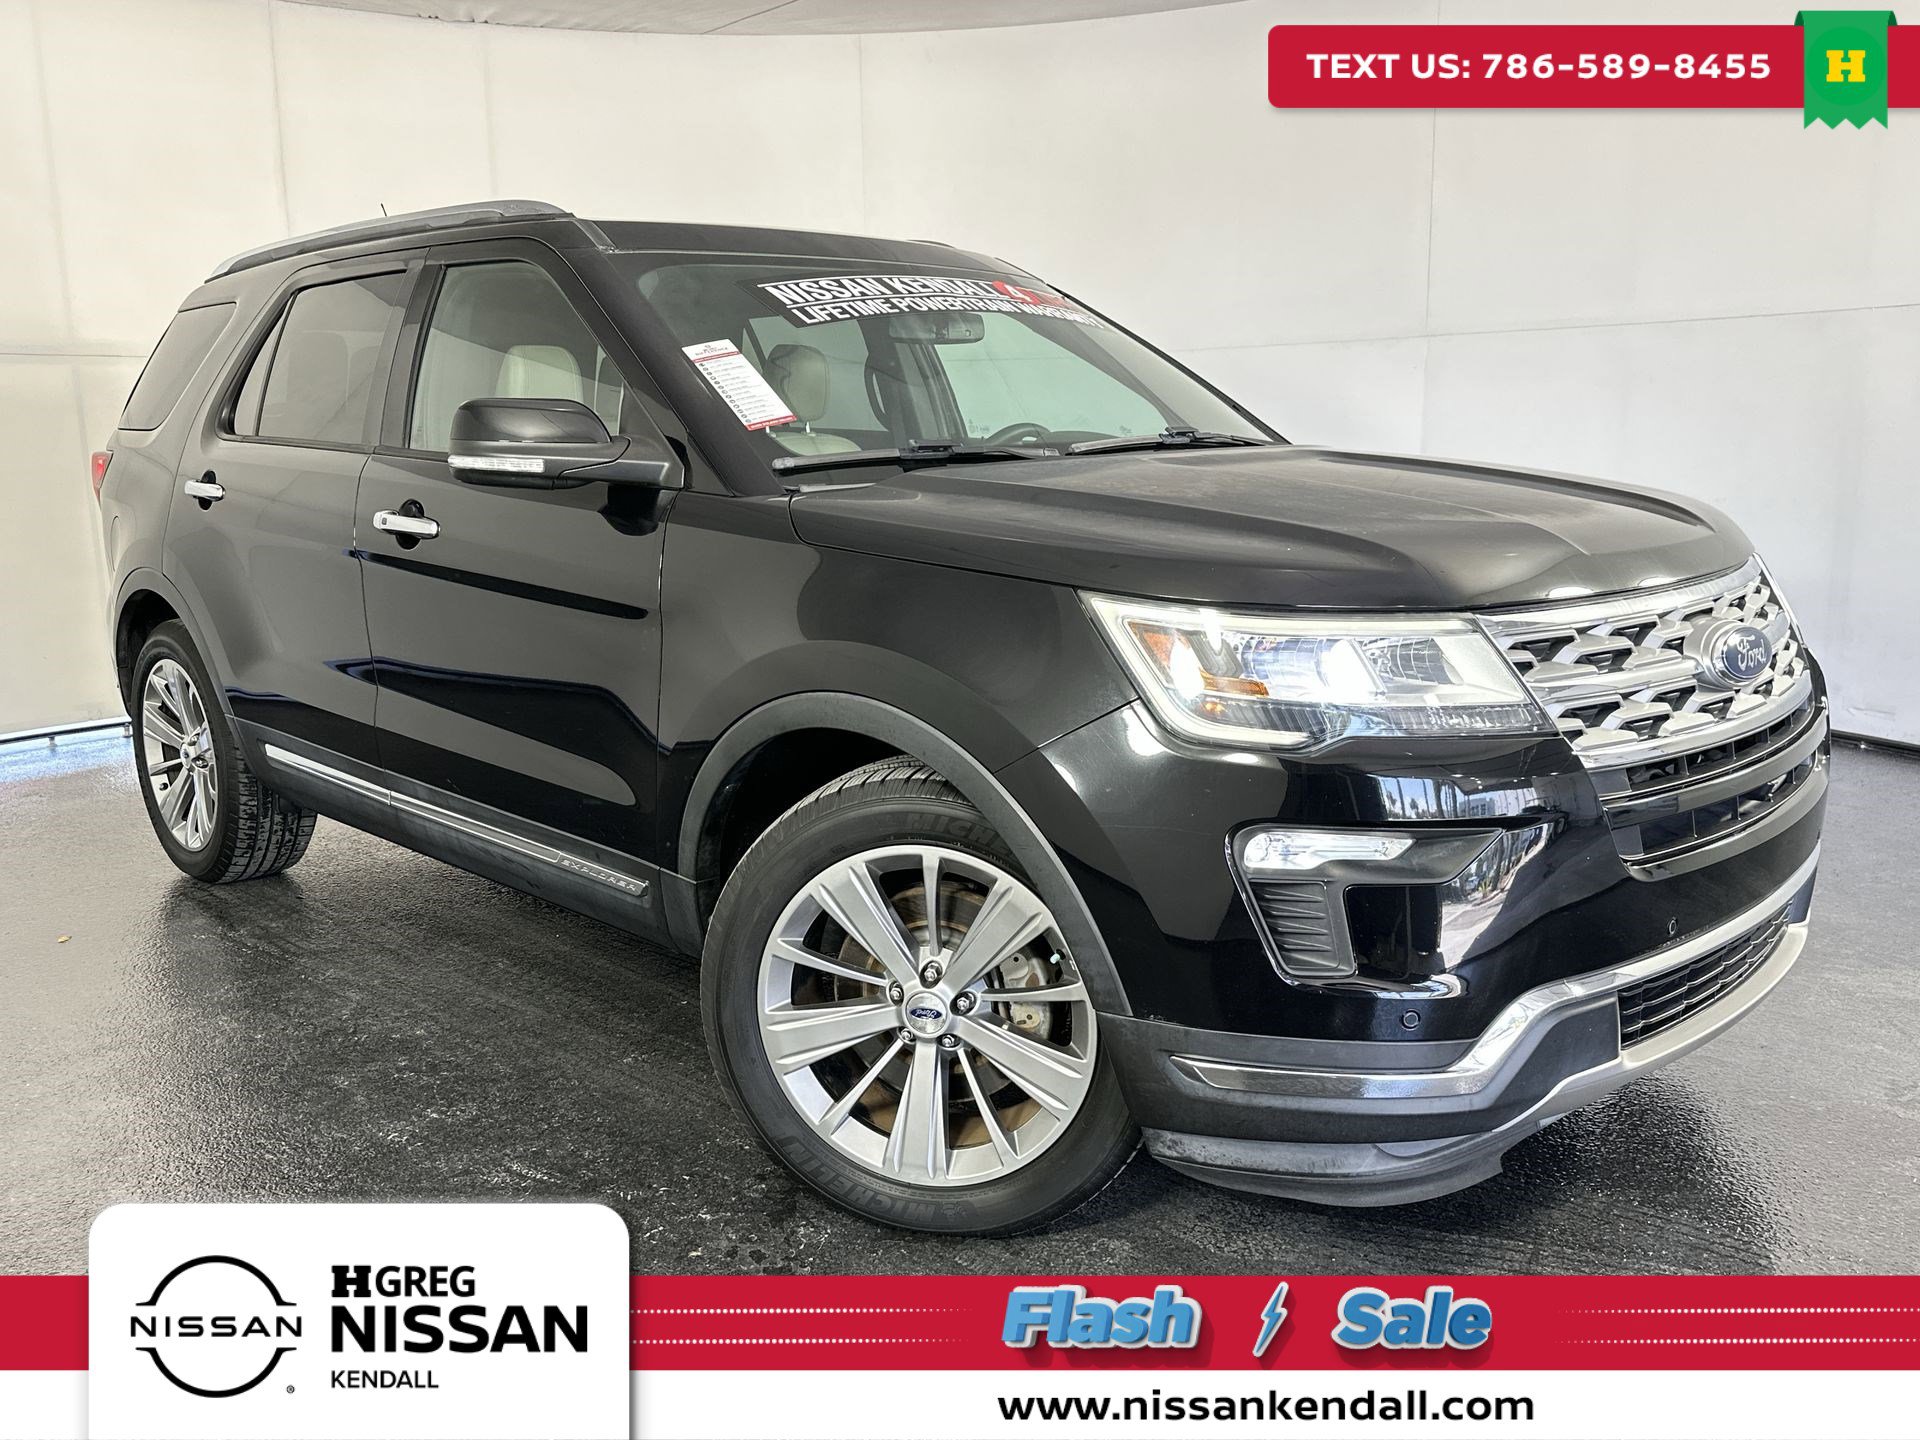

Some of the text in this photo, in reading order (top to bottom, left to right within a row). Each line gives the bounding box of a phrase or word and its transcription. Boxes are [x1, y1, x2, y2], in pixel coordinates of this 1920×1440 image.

[765, 278, 893, 304] NISSAN
[882, 277, 1009, 299] KENDALL
[791, 299, 900, 324] LIFETIME
[897, 297, 1022, 313] POWERTRAIN
[1736, 634, 1767, 671] Ford
